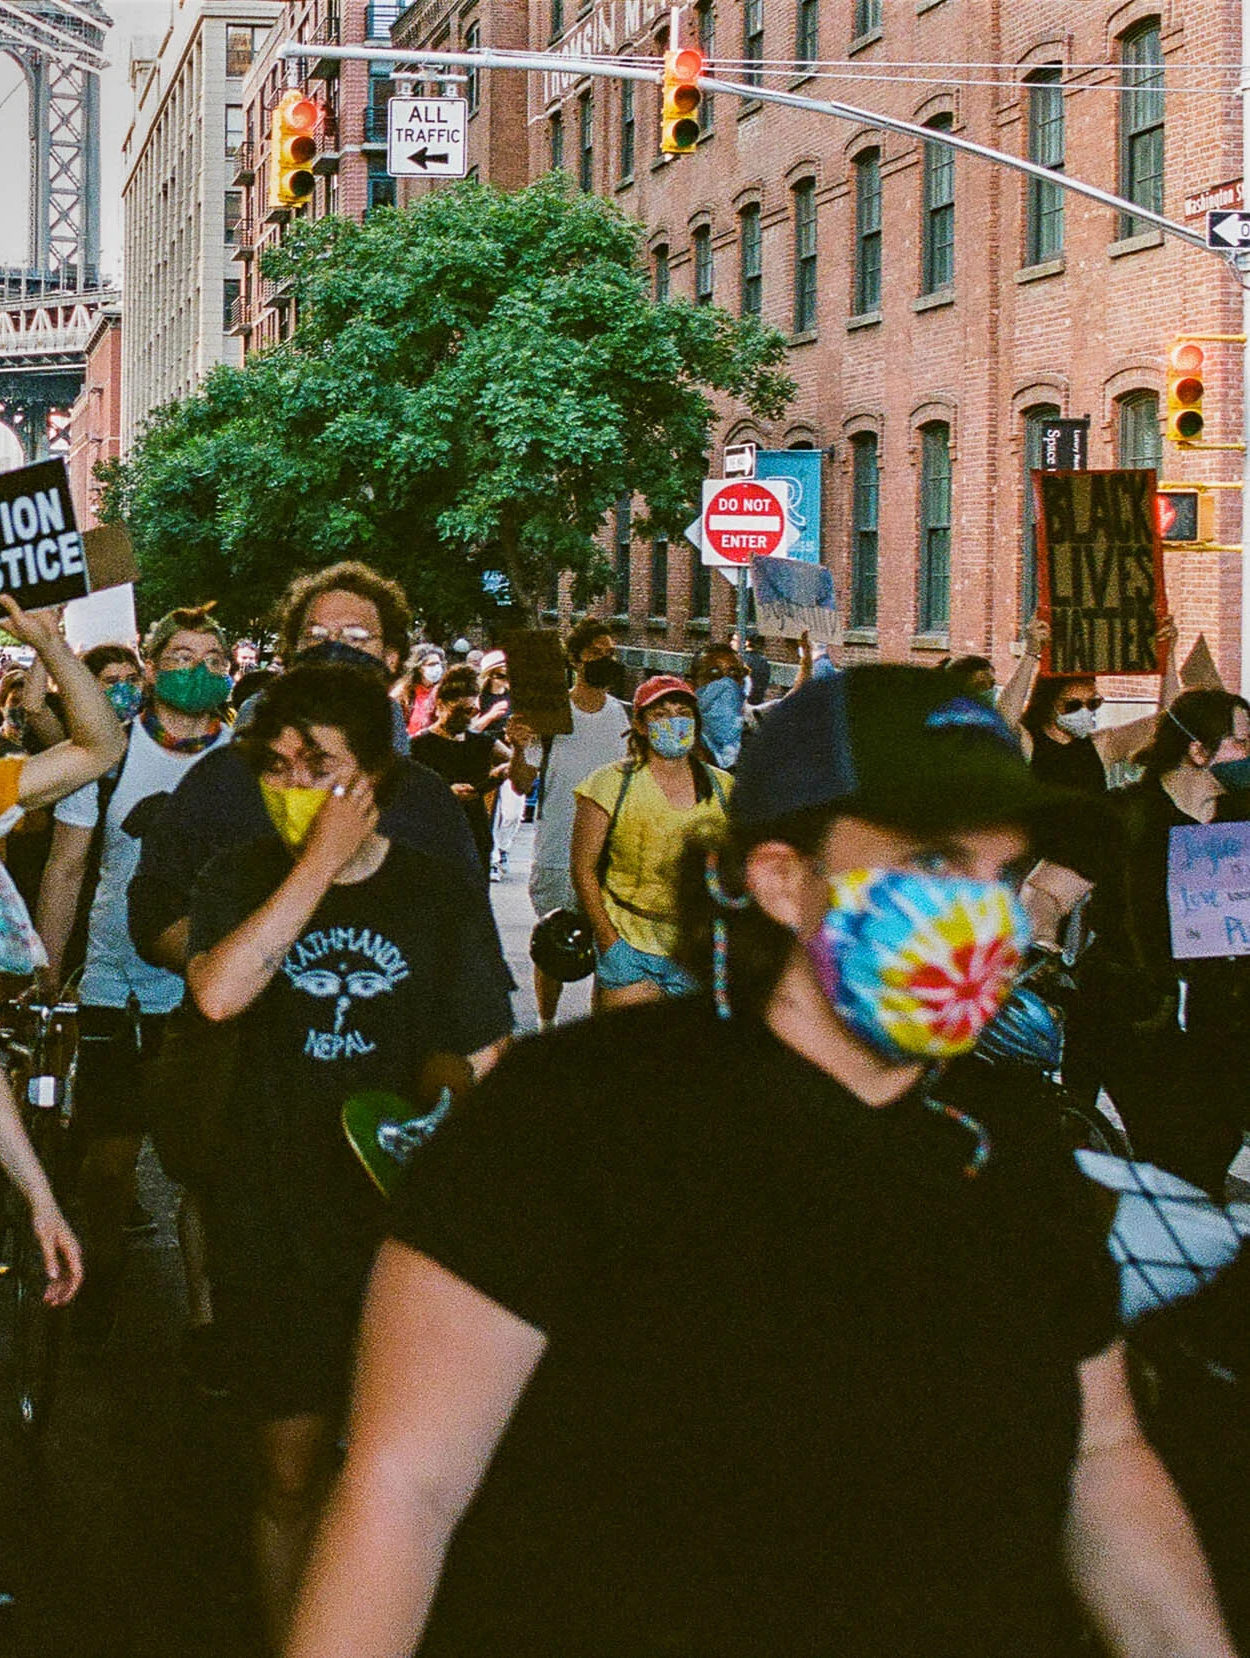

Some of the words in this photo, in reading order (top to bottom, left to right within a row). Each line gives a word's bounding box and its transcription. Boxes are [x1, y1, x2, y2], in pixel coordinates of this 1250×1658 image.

[408, 105, 448, 123] ALL
[395, 128, 460, 143] TRAFFIC
[1042, 429, 1062, 465] Space
[718, 498, 738, 511] DO
[743, 498, 771, 511] NOT
[1042, 474, 1154, 544] BLACK
[721, 534, 767, 548] ENTER
[1049, 544, 1154, 608] LIVES
[1052, 606, 1160, 672] MATTER
[281, 927, 410, 983] KATHMANDU
